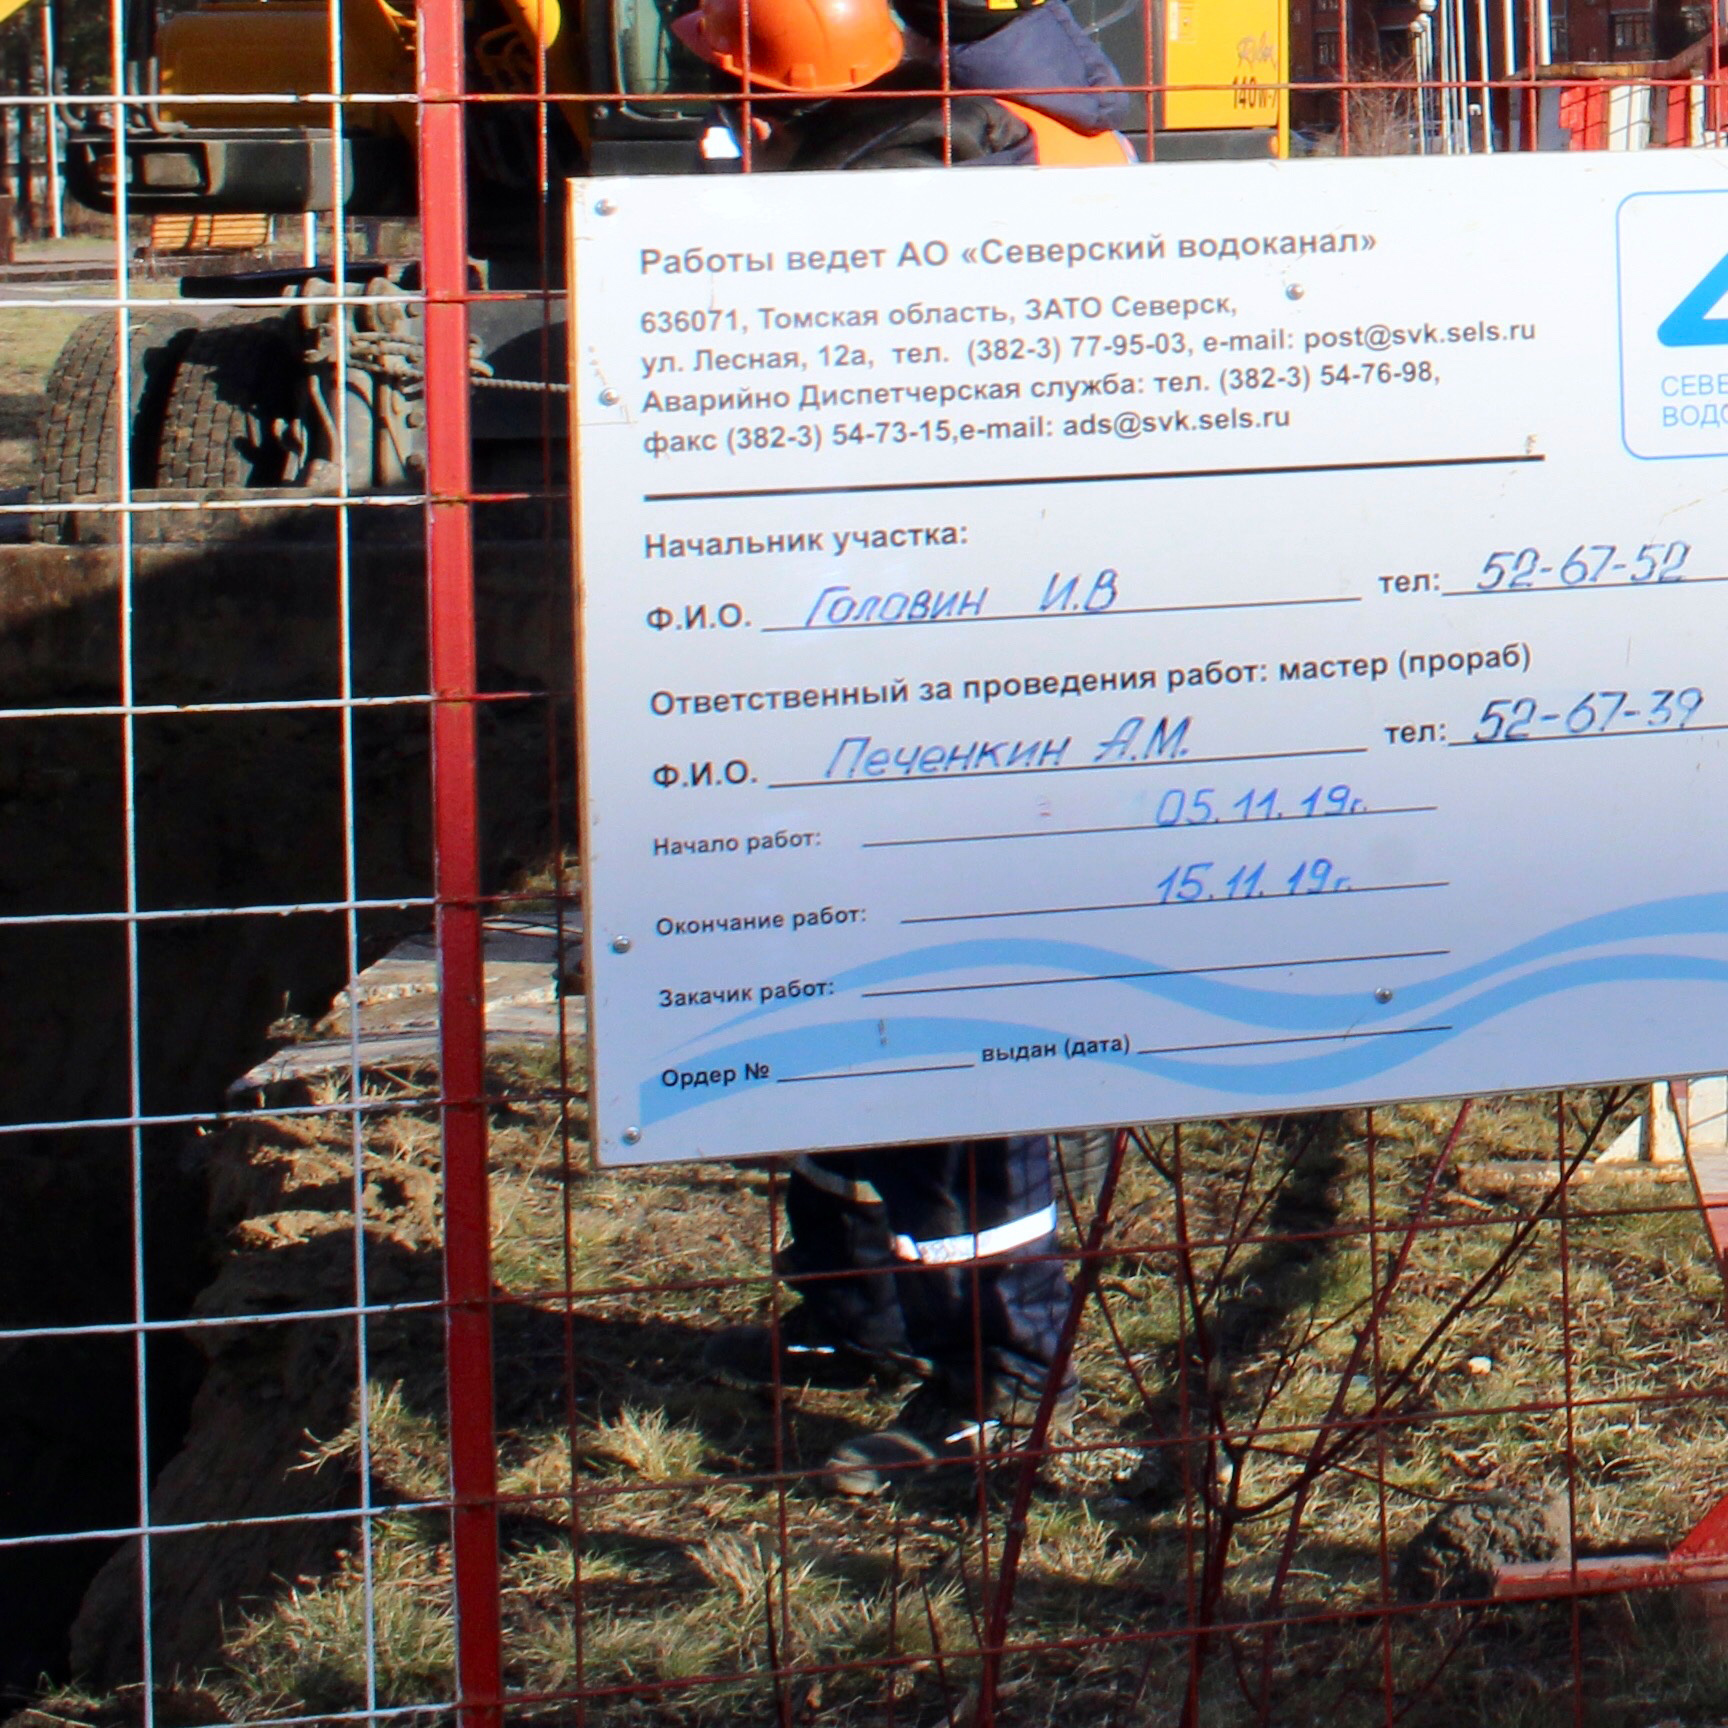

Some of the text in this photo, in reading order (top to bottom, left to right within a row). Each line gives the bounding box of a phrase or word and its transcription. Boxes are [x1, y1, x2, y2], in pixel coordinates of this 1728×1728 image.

[640, 233, 1376, 274] Работы ведет АО «Северский водоканал»
[640, 296, 1237, 334] 636071, Томская область, ЗАТО Северск,
[640, 321, 1536, 380] ул. Лесная, 12а, тел. (382-3) 77-95-03, e-mail: post@svk.sels.ru
[640, 361, 1440, 416] Аварийно Диспетчерская служба: тел. (382-3) 54-76-98,
[643, 431, 717, 459] факс
[726, 424, 822, 455] (382-3)
[1063, 408, 1290, 439] ads@svk.sels.ru
[644, 527, 967, 559] Начальник участка:
[1476, 539, 1691, 591] 52-67-52
[1378, 571, 1441, 596] тел:
[645, 603, 751, 631] Ф.И.О.
[804, 585, 989, 627] Головин
[648, 643, 1530, 716] Ответственный за проведения работ: мастер (прораб)
[1473, 687, 1704, 742] 52-67-39
[1384, 721, 1447, 746] тел:
[651, 760, 756, 788] Ф.И.О.
[825, 735, 1071, 779] Печенкин
[652, 830, 820, 856] Начало работ:
[653, 907, 865, 937] Окончание работ:
[658, 978, 835, 1009] Закачик работ:
[981, 1034, 1132, 1065] выдан (дата)
[661, 1061, 770, 1089] Ордер №
